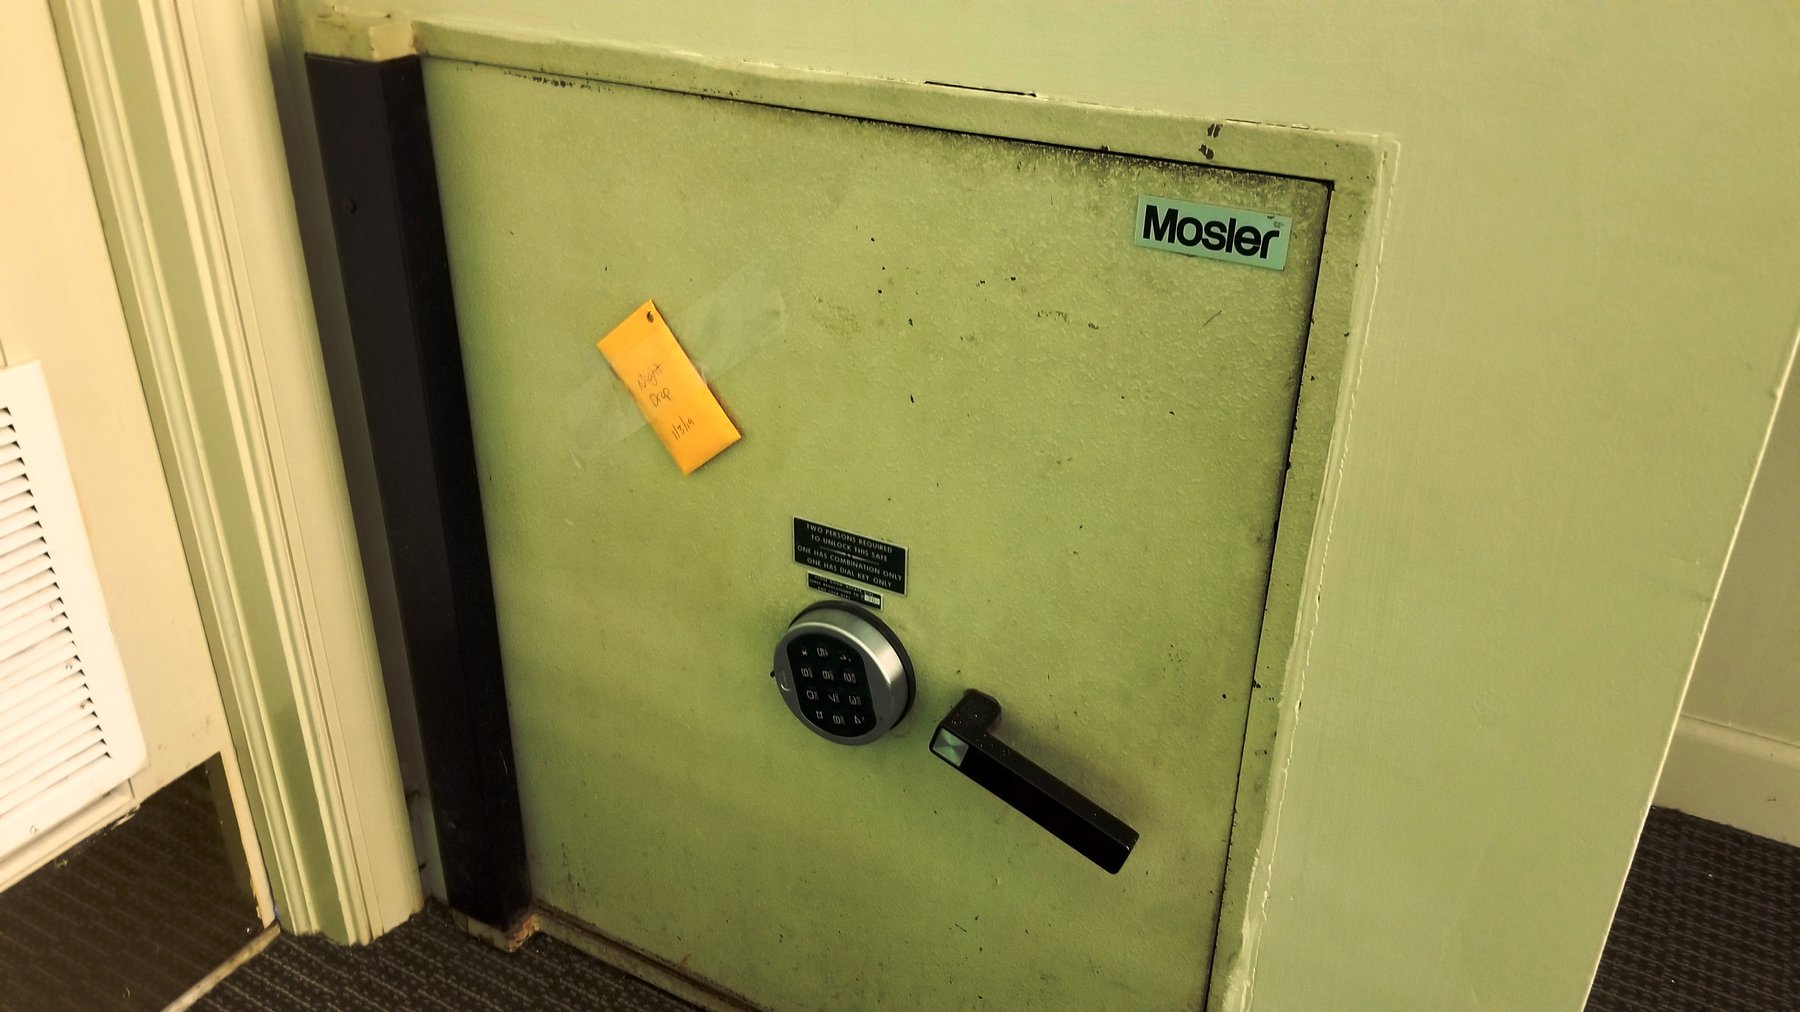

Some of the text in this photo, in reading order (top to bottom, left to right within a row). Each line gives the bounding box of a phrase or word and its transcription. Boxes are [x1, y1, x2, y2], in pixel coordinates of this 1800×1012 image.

[1142, 204, 1280, 259] Mosler
[671, 415, 695, 441] 1/3/19
[806, 522, 892, 554] TWO PERSONS REQUIRED
[811, 534, 887, 562] TO UNLOCK THIS SAFE
[797, 544, 903, 582] ONE HAS COMBINATION ONLY
[806, 557, 892, 588] ONE HAS DIAL KEY ONLY
